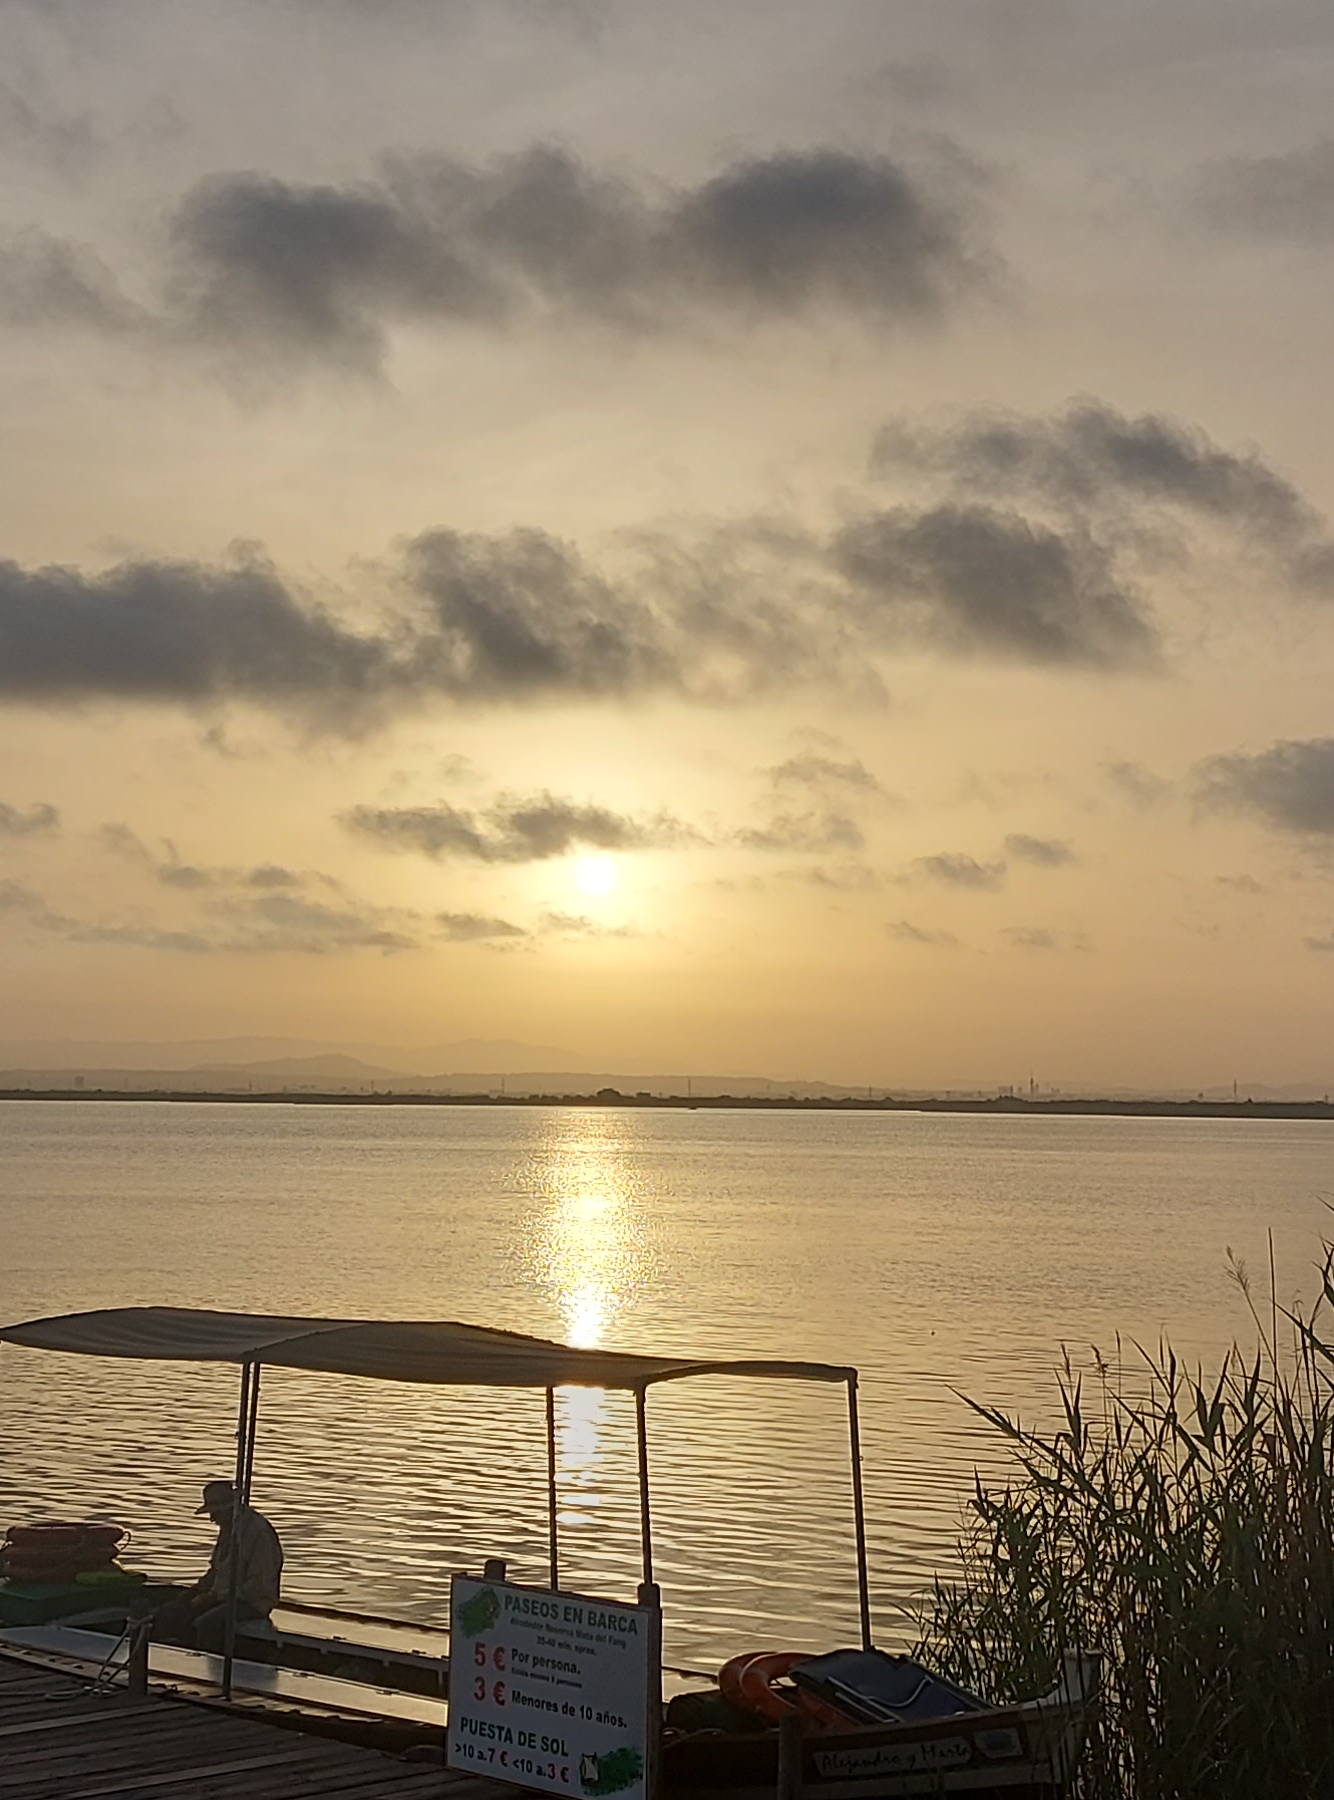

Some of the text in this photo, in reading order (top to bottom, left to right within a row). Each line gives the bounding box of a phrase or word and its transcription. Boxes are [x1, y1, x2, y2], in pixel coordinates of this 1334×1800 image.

[504, 1595, 638, 1635] PASEOS EN BARCA
[474, 1642, 581, 1675] 5 € Por persona.
[473, 1676, 628, 1729] 3 € Menores de 10 años.
[460, 1717, 569, 1758] PUESTA DE SOL
[500, 1751, 508, 1767] €
[560, 1766, 569, 1784] €
